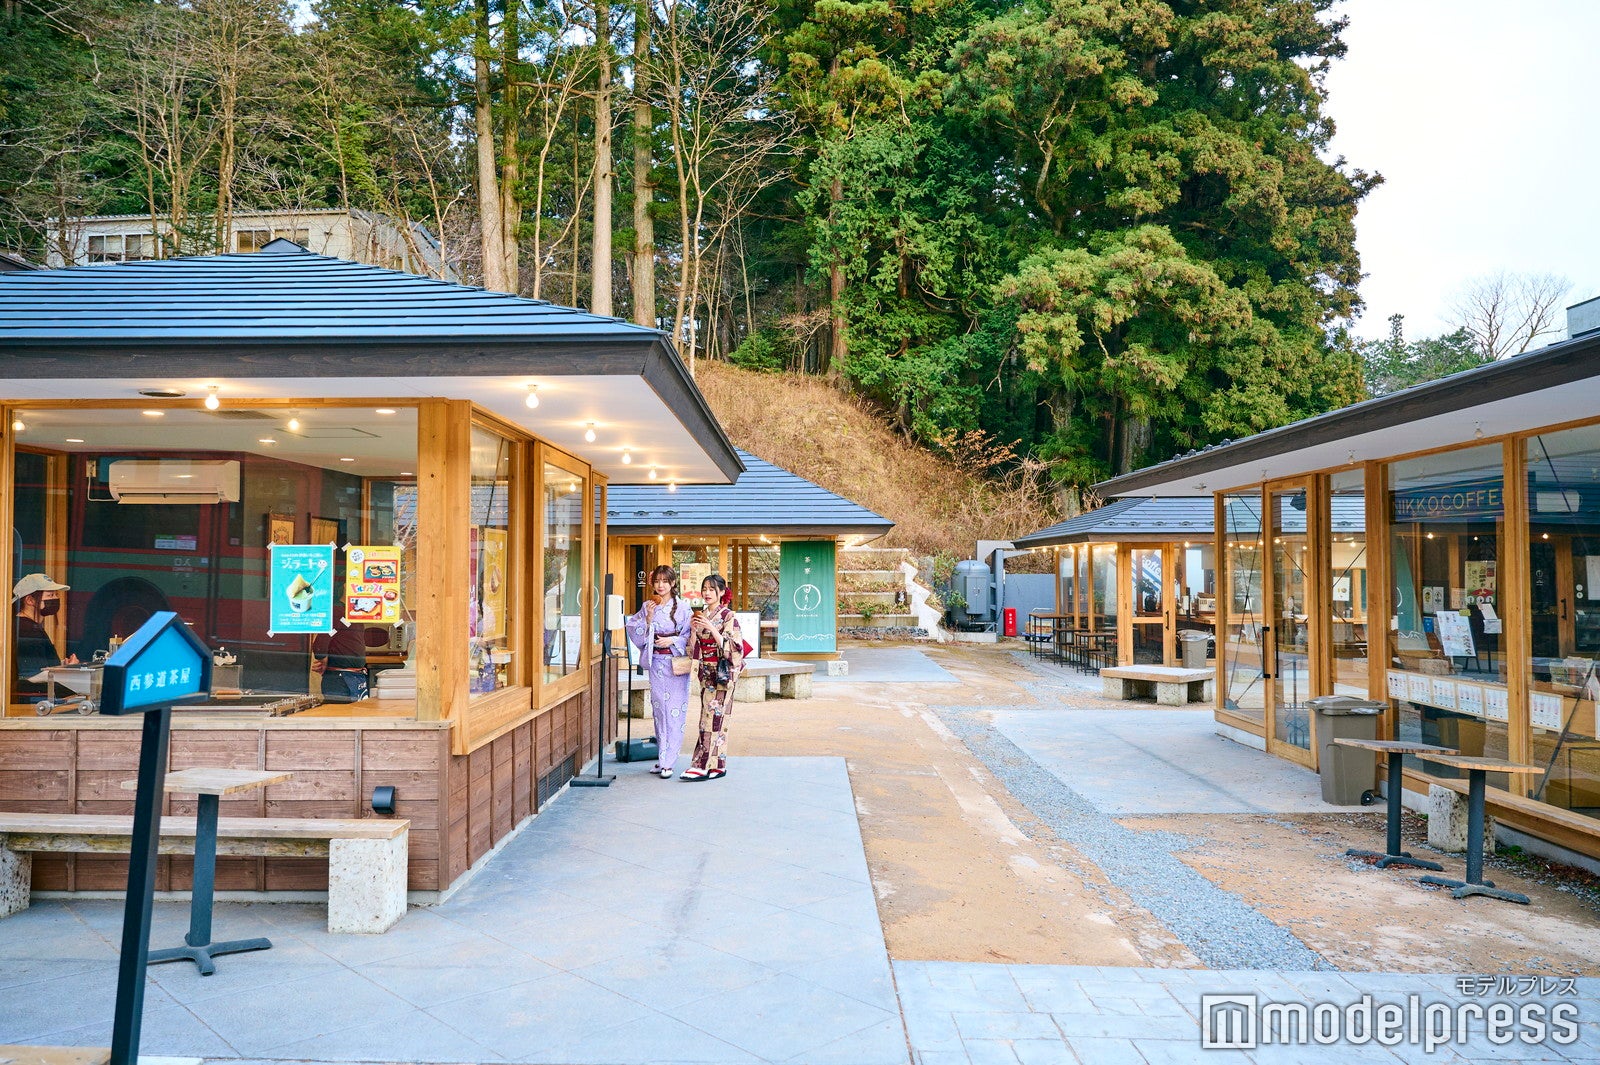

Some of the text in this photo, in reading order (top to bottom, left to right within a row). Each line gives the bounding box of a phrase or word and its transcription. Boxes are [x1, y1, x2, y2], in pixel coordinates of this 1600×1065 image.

[1393, 489, 1504, 514] NIKKOCOFFE
[281, 557, 318, 569] ジェラート
[129, 667, 191, 691] 西参道茶屋
